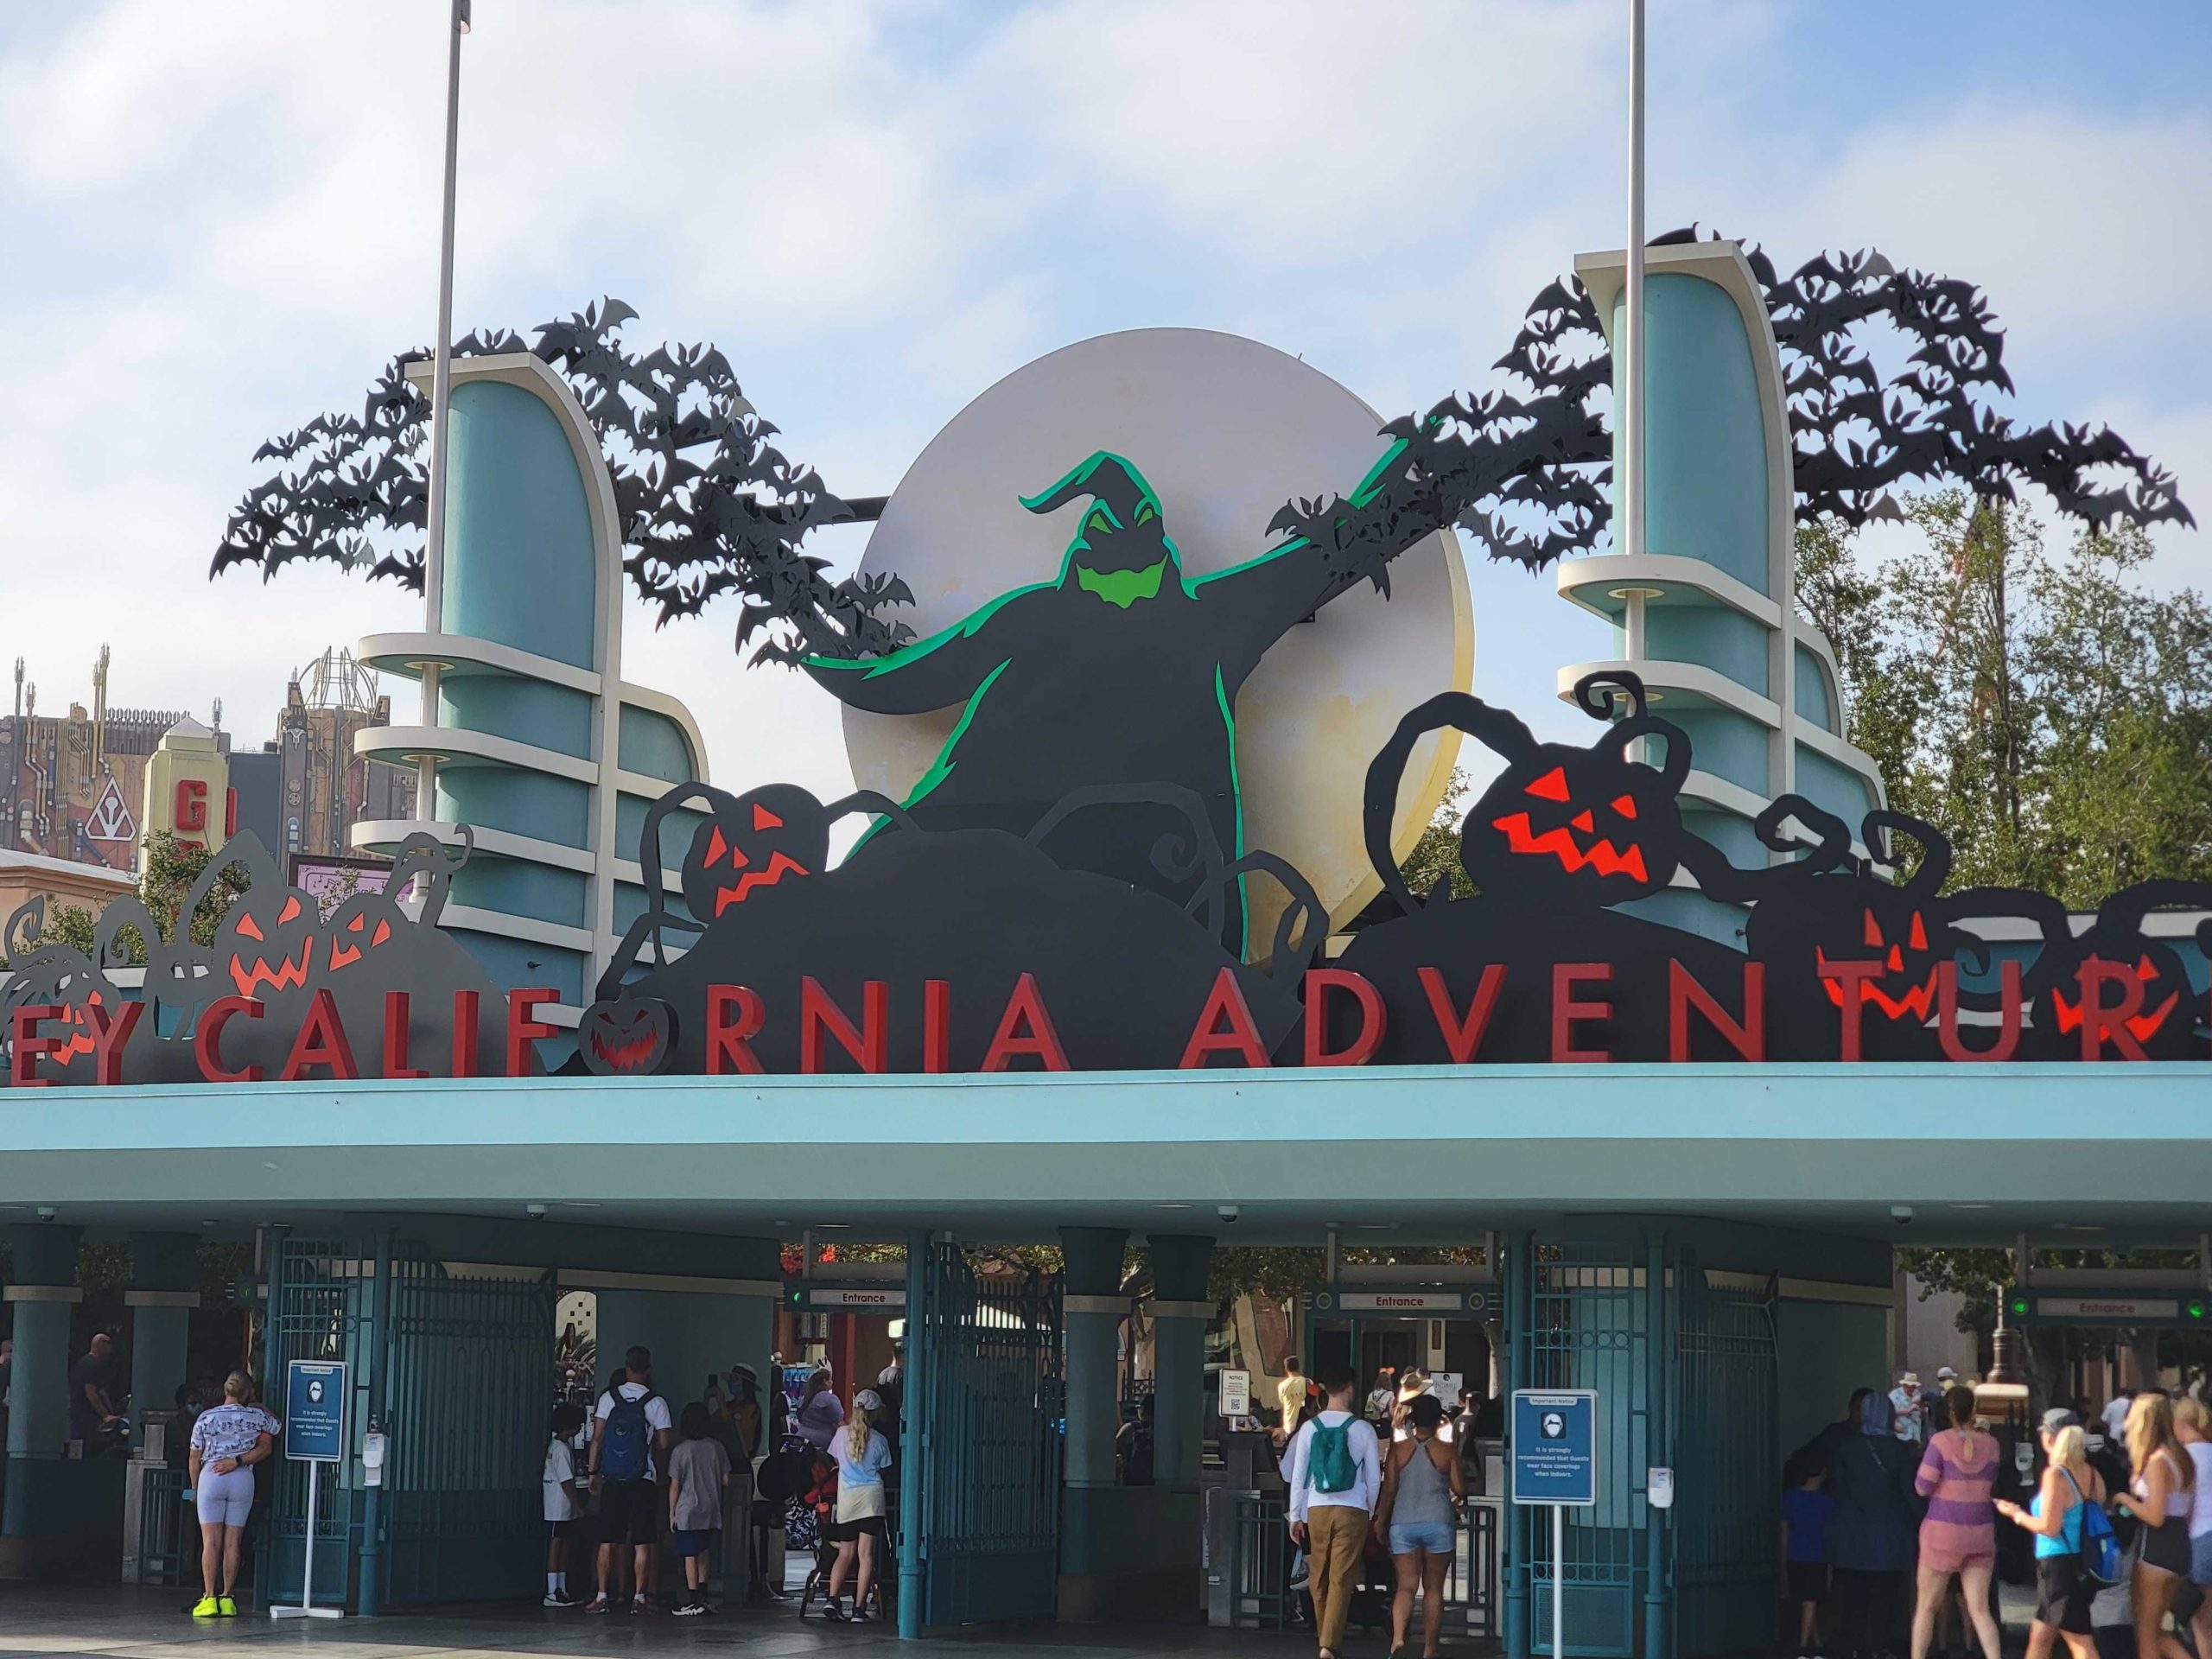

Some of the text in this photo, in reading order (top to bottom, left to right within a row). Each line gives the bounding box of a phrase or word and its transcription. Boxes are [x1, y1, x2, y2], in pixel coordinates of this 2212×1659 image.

[1178, 957, 2212, 1070] ADVENTUR
[842, 1293, 886, 1303] Entrance
[1376, 1296, 1424, 1306] Entrance
[2079, 1302, 2136, 1313] Entrance
